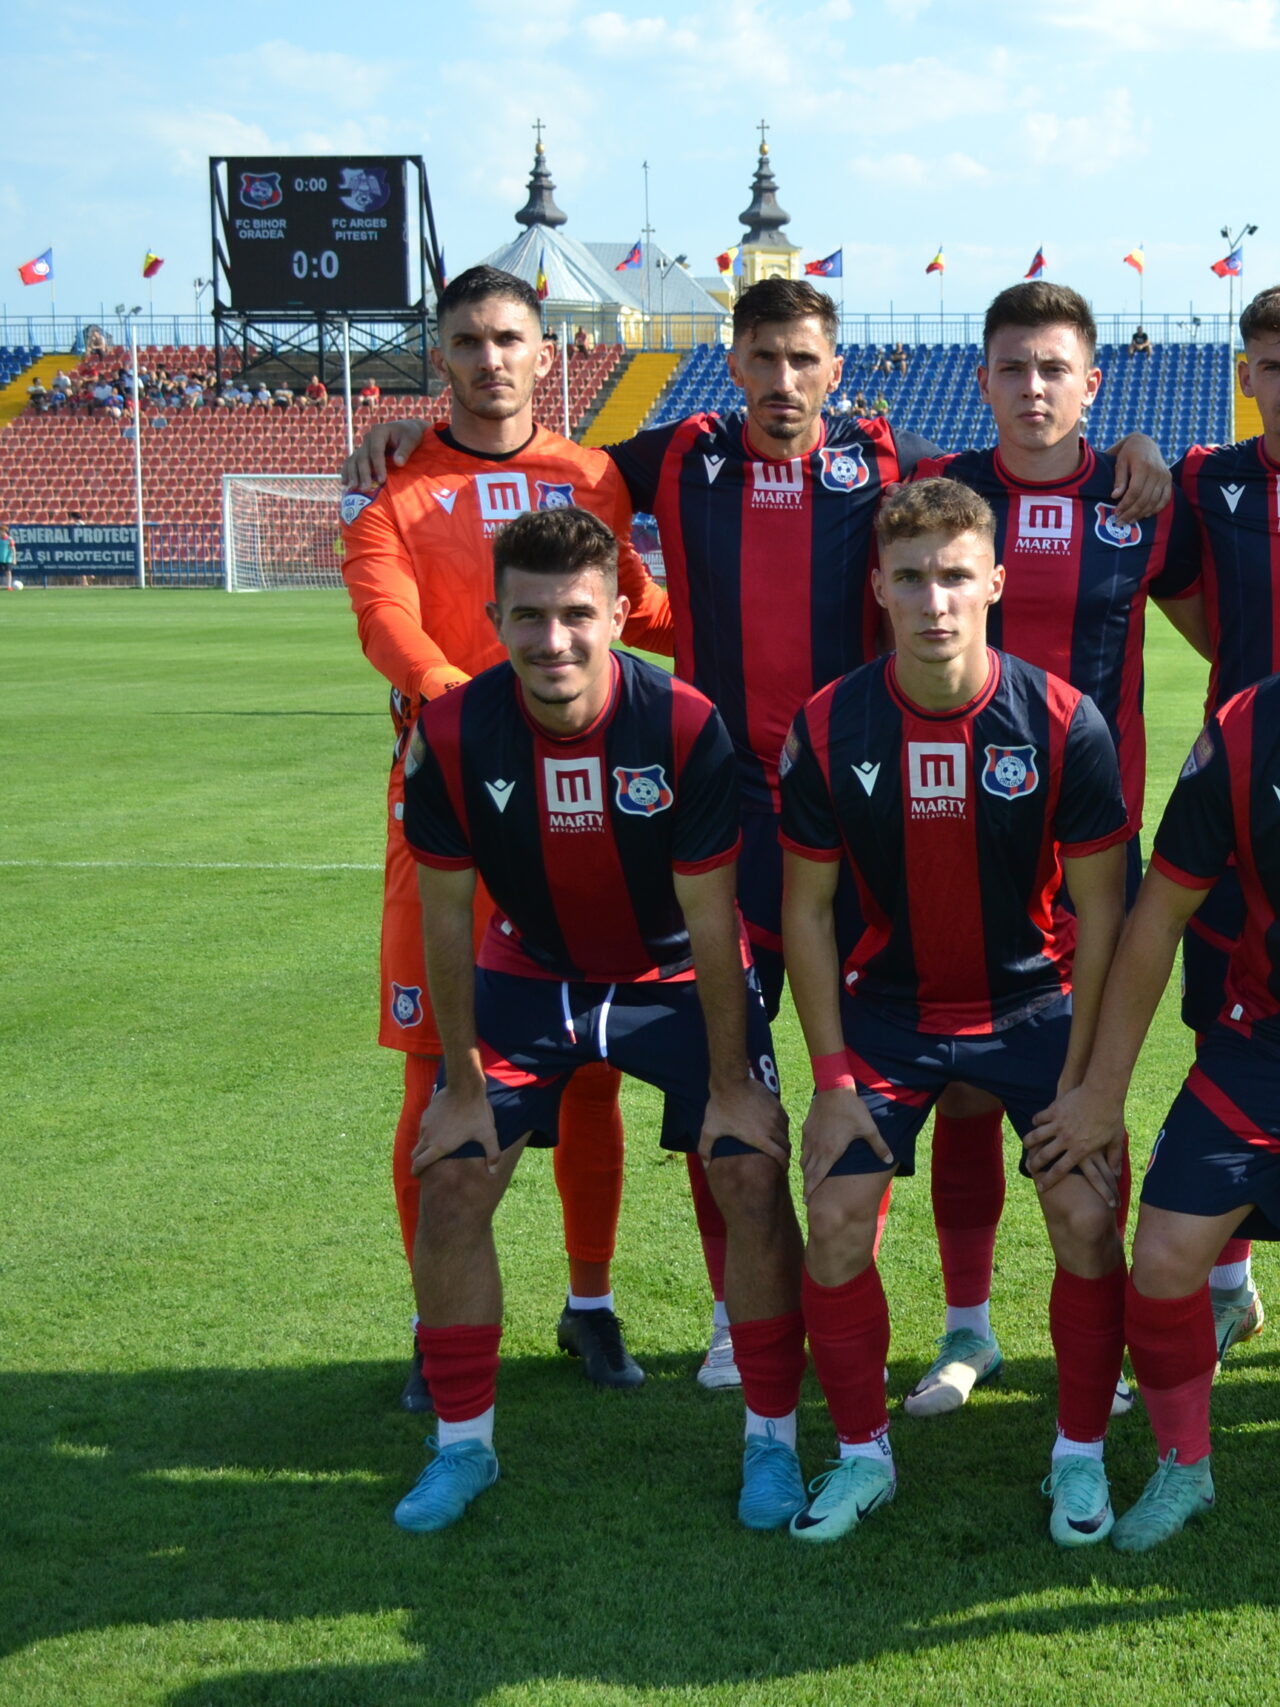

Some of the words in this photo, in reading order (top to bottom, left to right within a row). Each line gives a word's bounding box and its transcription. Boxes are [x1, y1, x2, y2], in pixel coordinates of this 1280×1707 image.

[294, 178, 327, 192] 0:00
[235, 219, 251, 229] FC
[252, 219, 287, 229] BIHOR
[332, 218, 348, 228] FC
[349, 218, 387, 228] ARGES
[239, 230, 285, 240] ORADEA
[335, 231, 377, 241] PITESTI
[293, 250, 339, 280] 0:0
[751, 490, 803, 505] MARTY
[9, 527, 71, 543] GENERAL
[73, 527, 138, 543] PROTECT
[1015, 538, 1071, 551] MARTY
[911, 799, 966, 814] MARTY
[550, 813, 604, 828] MARTY
